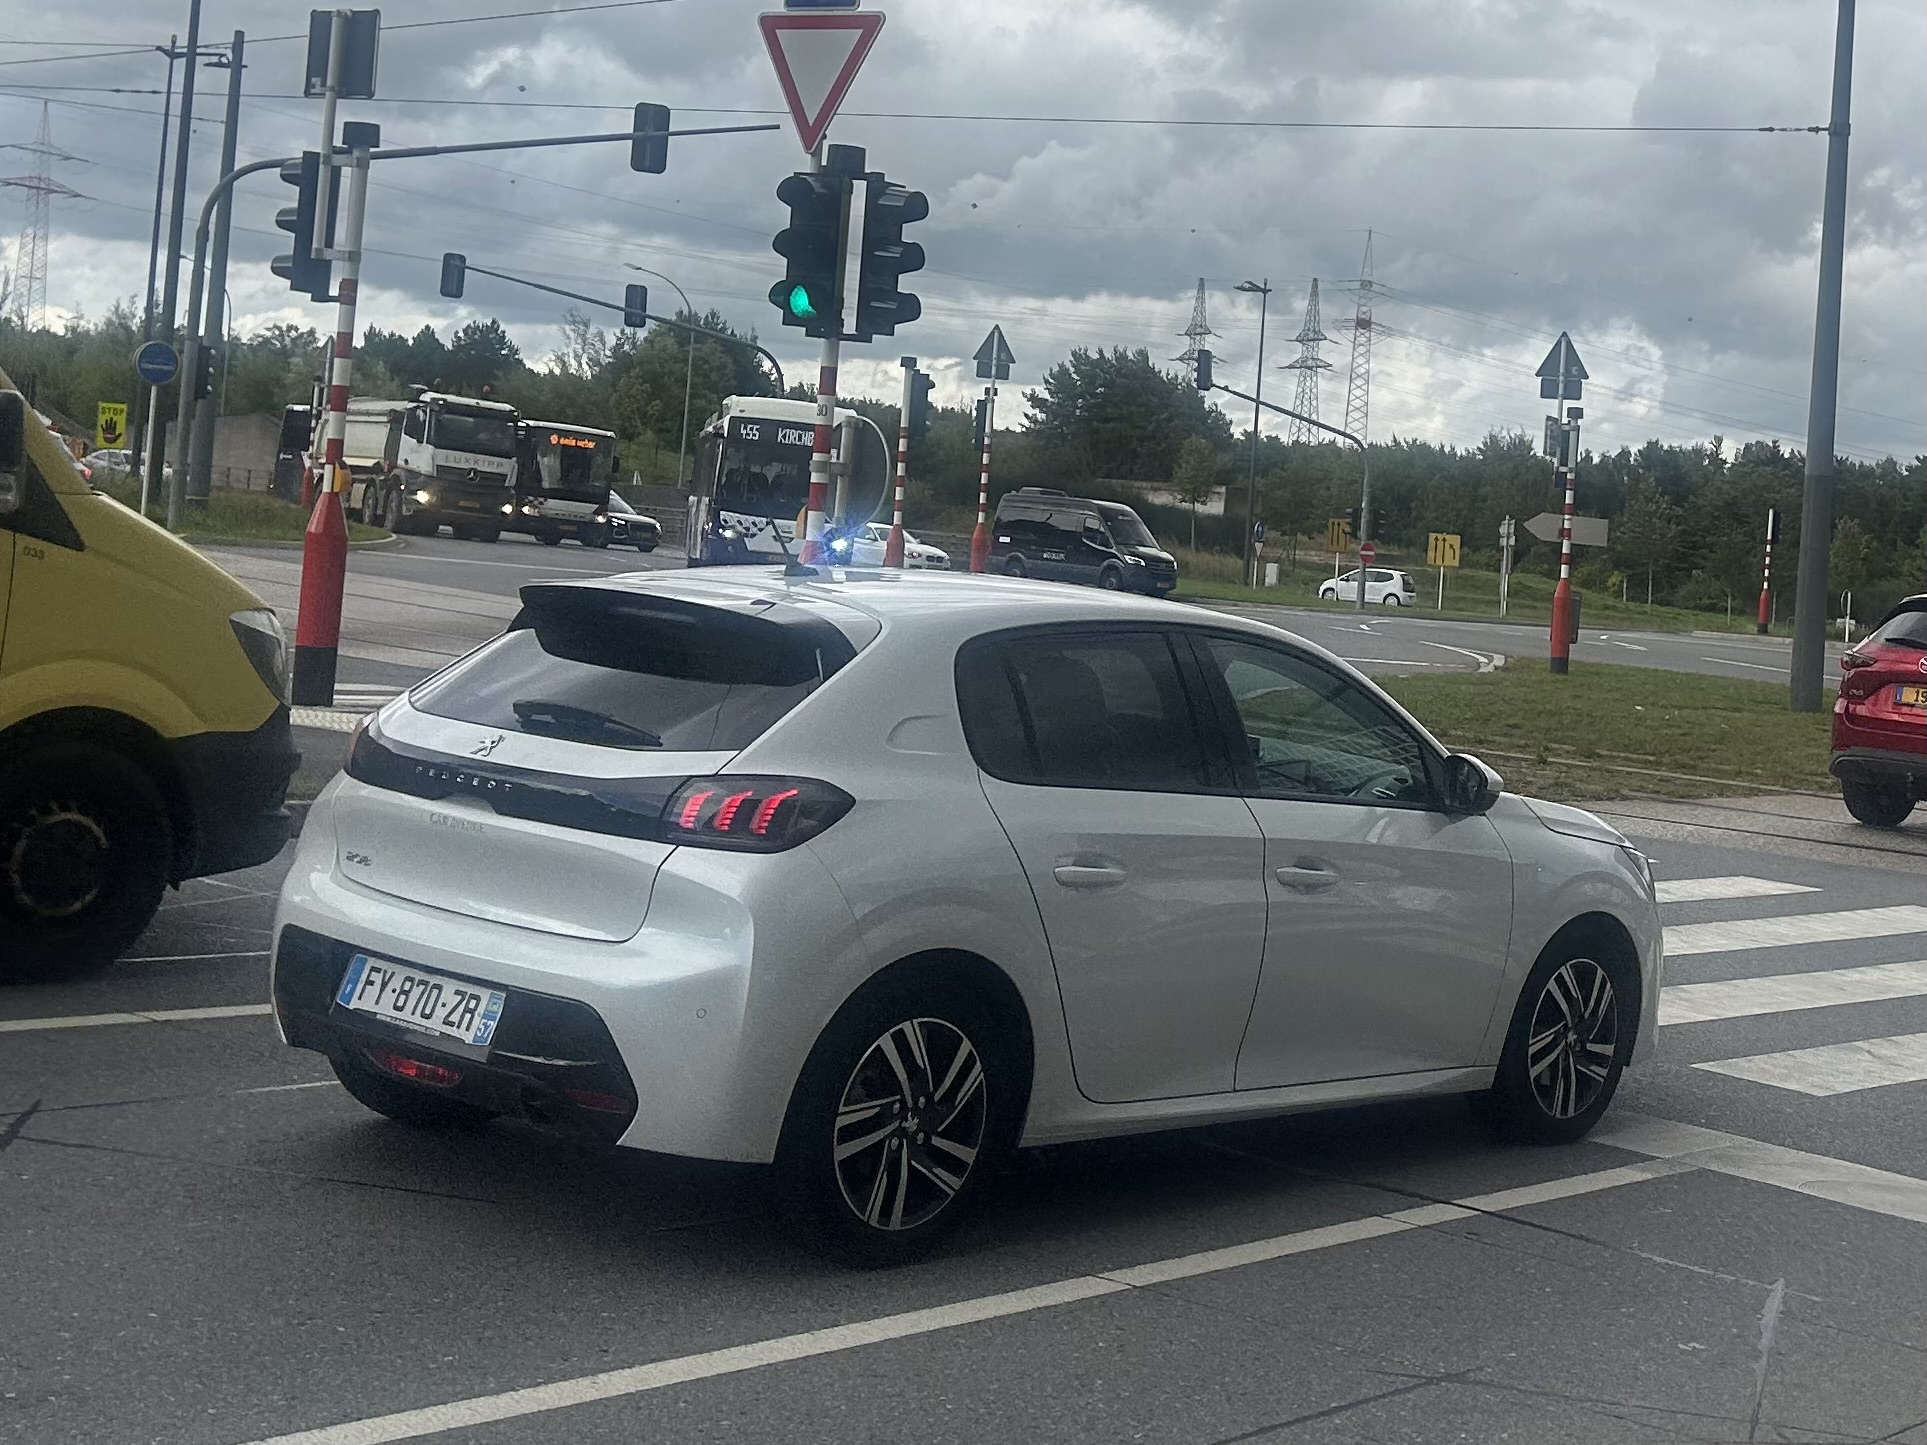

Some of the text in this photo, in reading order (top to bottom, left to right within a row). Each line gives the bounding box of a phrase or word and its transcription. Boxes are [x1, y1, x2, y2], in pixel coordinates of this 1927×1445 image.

[101, 406, 125, 416] STOP
[740, 423, 814, 447] 455 KIRCHB
[415, 766, 513, 792] PEUGEOT
[476, 1018, 495, 1038] 57
